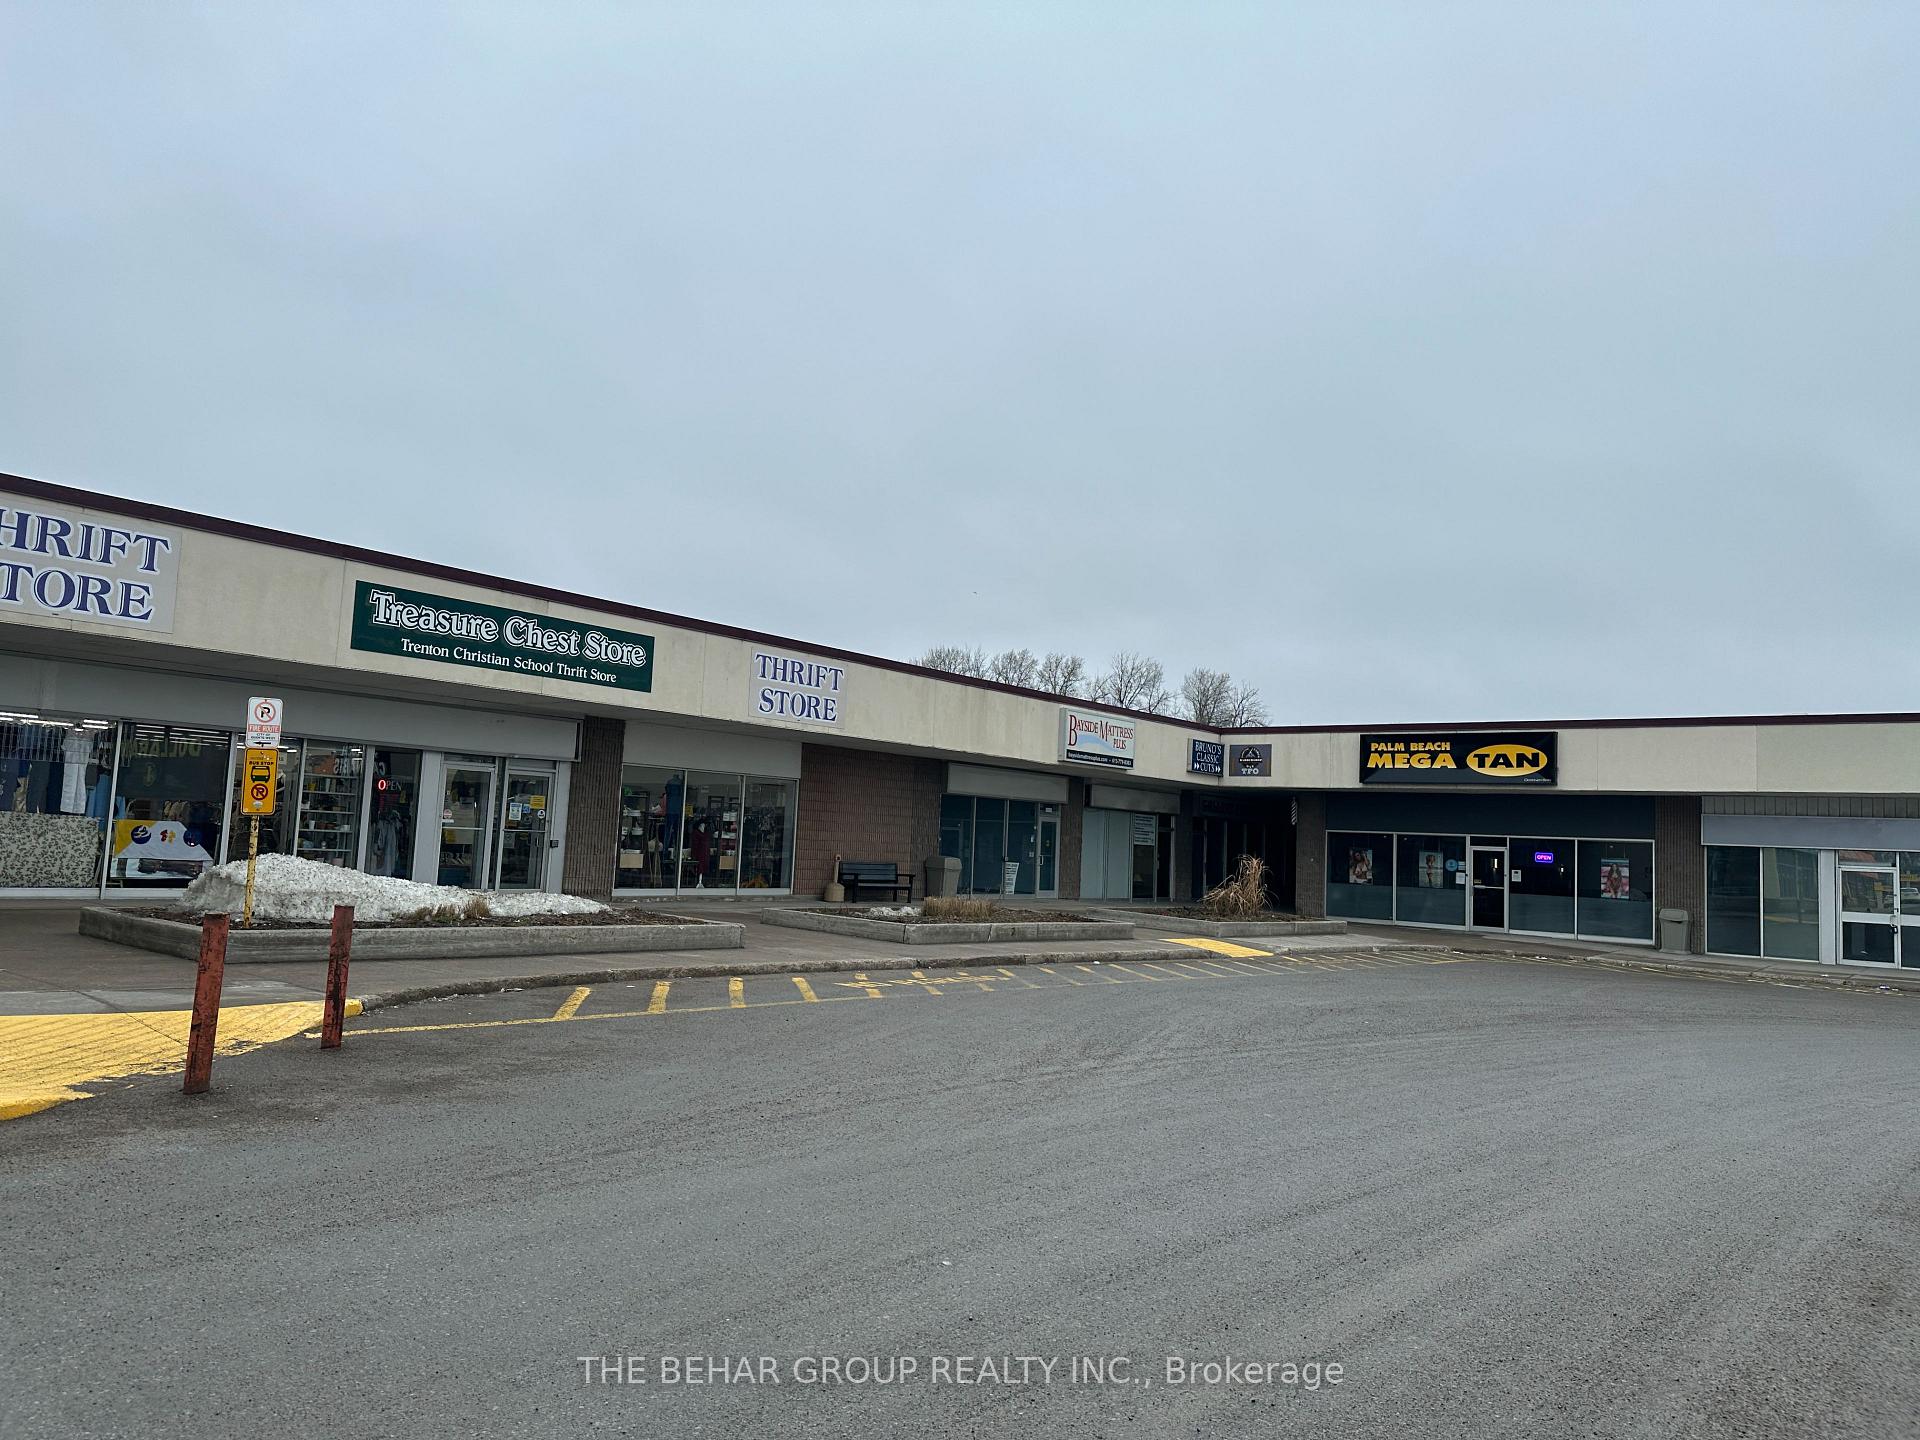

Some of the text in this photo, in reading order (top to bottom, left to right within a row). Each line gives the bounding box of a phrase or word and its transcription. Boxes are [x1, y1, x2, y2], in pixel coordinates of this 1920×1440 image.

[0, 507, 170, 572] HRIFT
[0, 562, 153, 621] TORE
[369, 588, 647, 667] Treasure Chest Store
[401, 638, 617, 683] Trenton Christian School Thrift Store
[755, 653, 844, 691] THRIFT
[759, 687, 837, 722] STORE
[249, 724, 279, 733] FIRE ROUTE
[1195, 741, 1222, 755] BRUNO'S
[1370, 741, 1451, 752] PALM BEACH
[1196, 752, 1220, 764] CLASSIC
[1366, 752, 1540, 769] MEGA TAN
[1200, 763, 1215, 773] CUTS
[378, 779, 402, 791] OPEN
